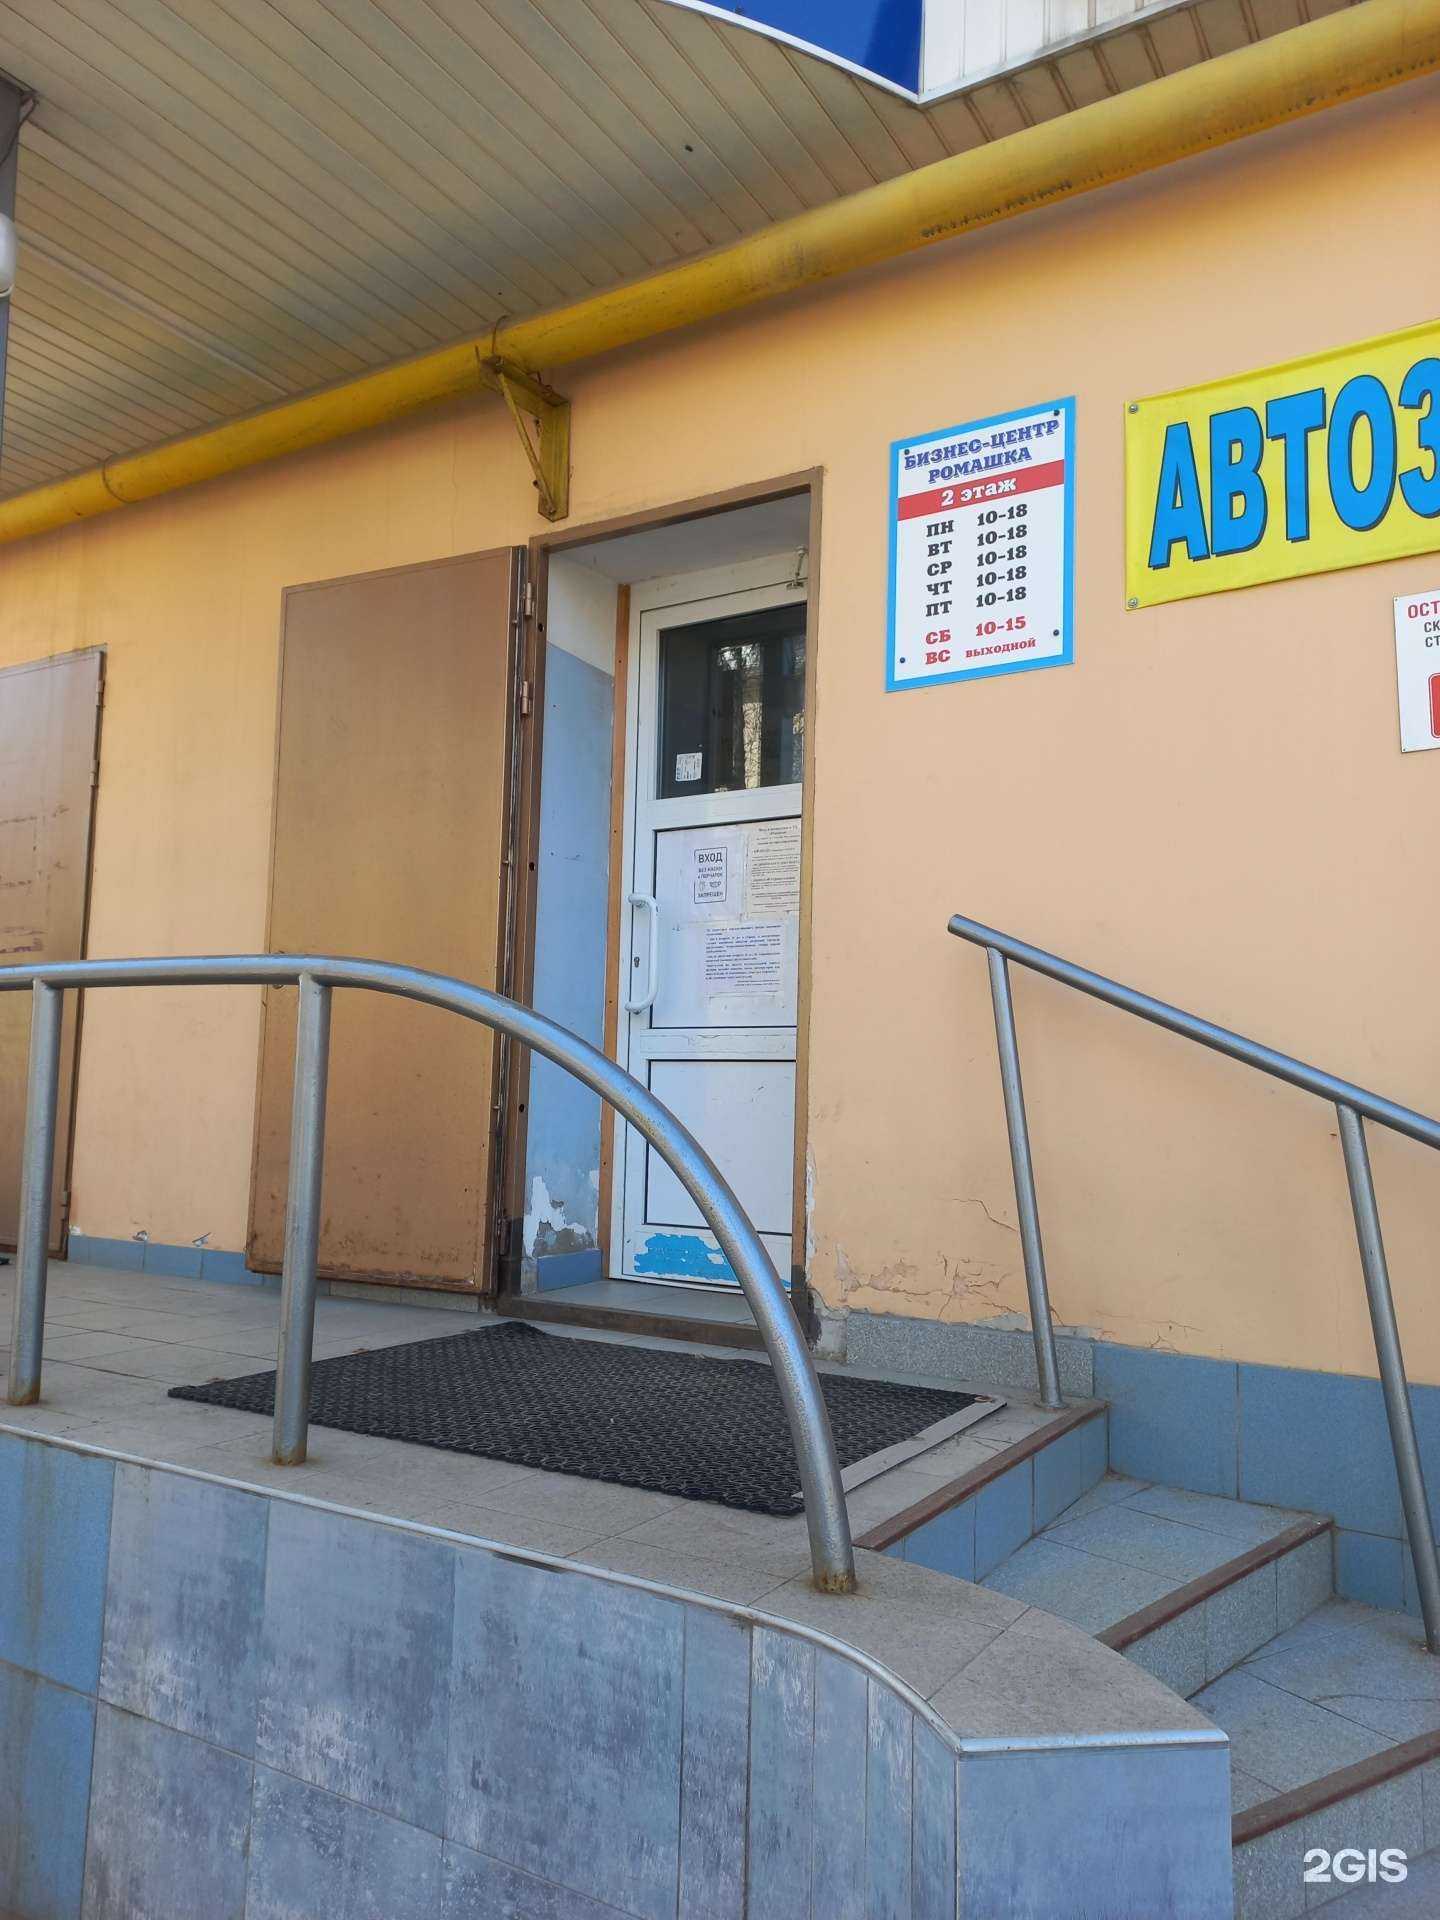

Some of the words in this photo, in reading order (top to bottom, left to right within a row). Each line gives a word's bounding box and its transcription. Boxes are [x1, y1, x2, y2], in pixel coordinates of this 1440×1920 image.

[904, 419, 1060, 470] БИЗНЕС-ЦЕНТР
[928, 446, 1032, 484] РОМАШКА
[1147, 357, 1440, 570] АВТОЗ
[941, 489, 954, 507] 2
[960, 477, 1017, 502] этаж
[926, 520, 954, 538] ПН
[976, 503, 1028, 526] 10-18
[927, 540, 953, 557] ВТ
[976, 524, 1028, 547] 10-18
[926, 560, 953, 577] СР
[976, 545, 1027, 567] 10-18
[926, 580, 953, 596] ЧТ
[976, 565, 1027, 588] 10-18
[925, 600, 953, 617] ПТ
[976, 586, 1027, 608] 10-18
[925, 629, 951, 645] СБ
[975, 615, 1026, 636] 10-15
[925, 649, 951, 665] ВС
[698, 852, 723, 864] ВХОД
